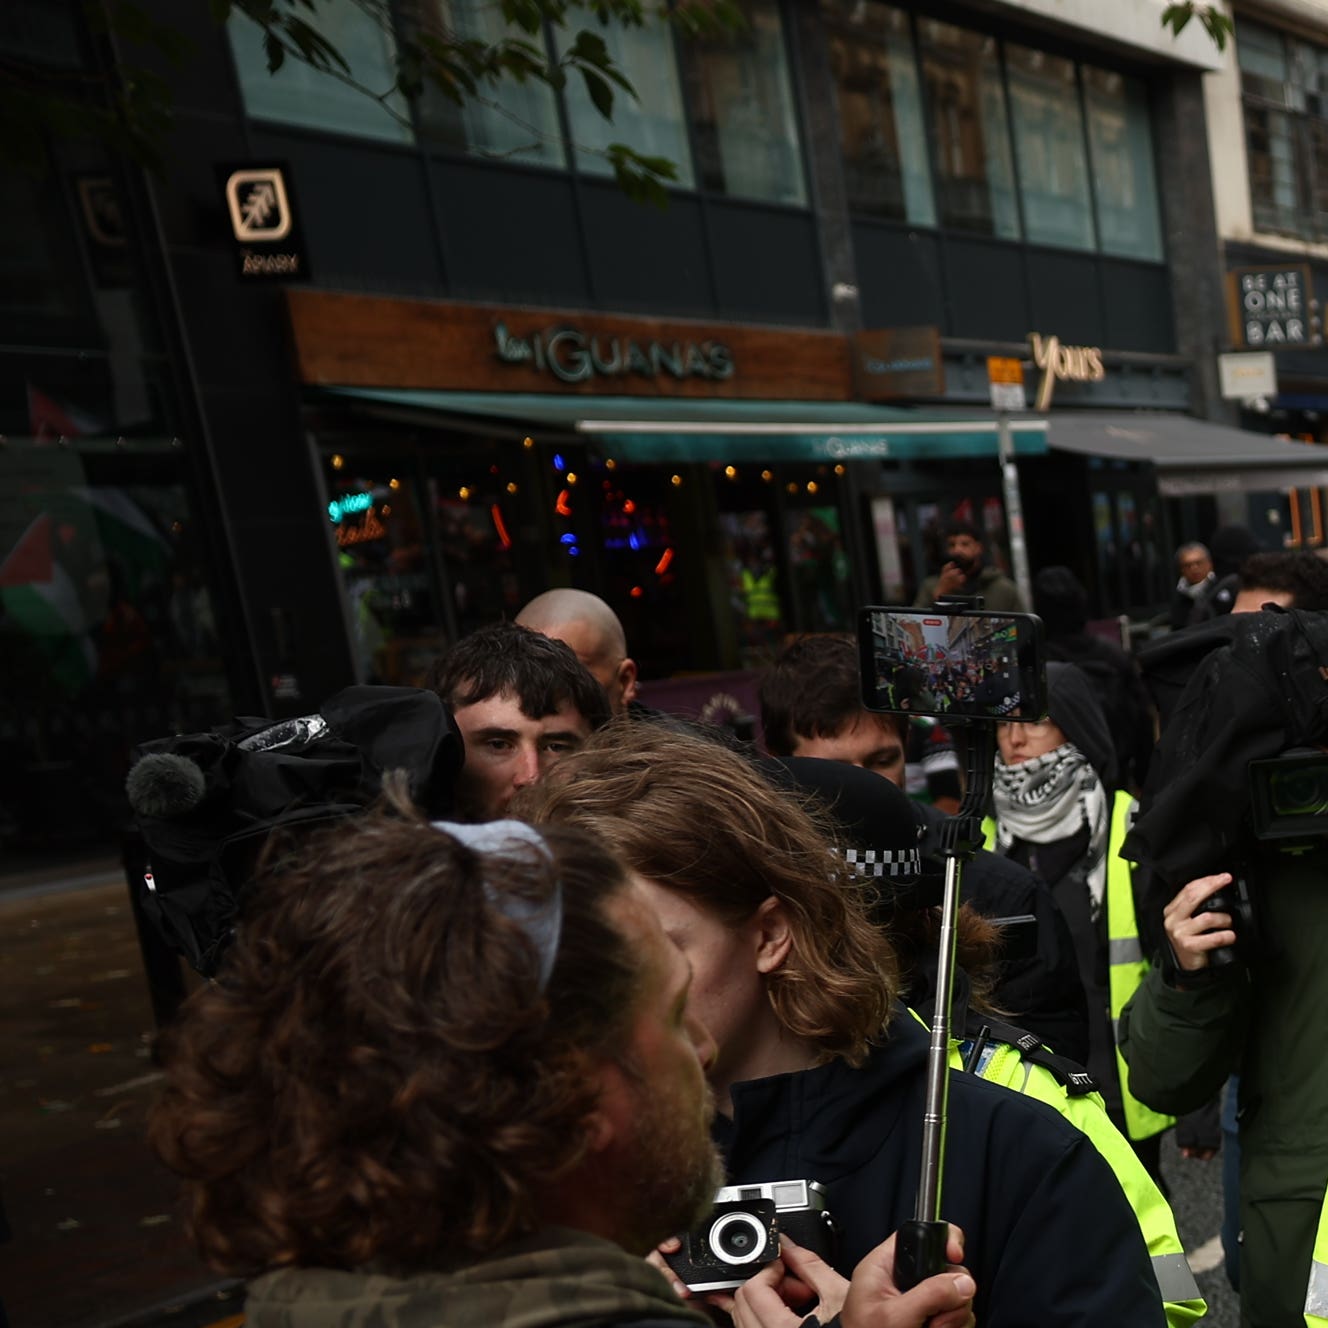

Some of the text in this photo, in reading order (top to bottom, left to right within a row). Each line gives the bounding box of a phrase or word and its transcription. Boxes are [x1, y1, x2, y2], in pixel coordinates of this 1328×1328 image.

[1244, 288, 1302, 312] ONE
[1246, 319, 1304, 345] BAR
[533, 329, 734, 383] IGUANAS
[1028, 332, 1105, 411] Yours
